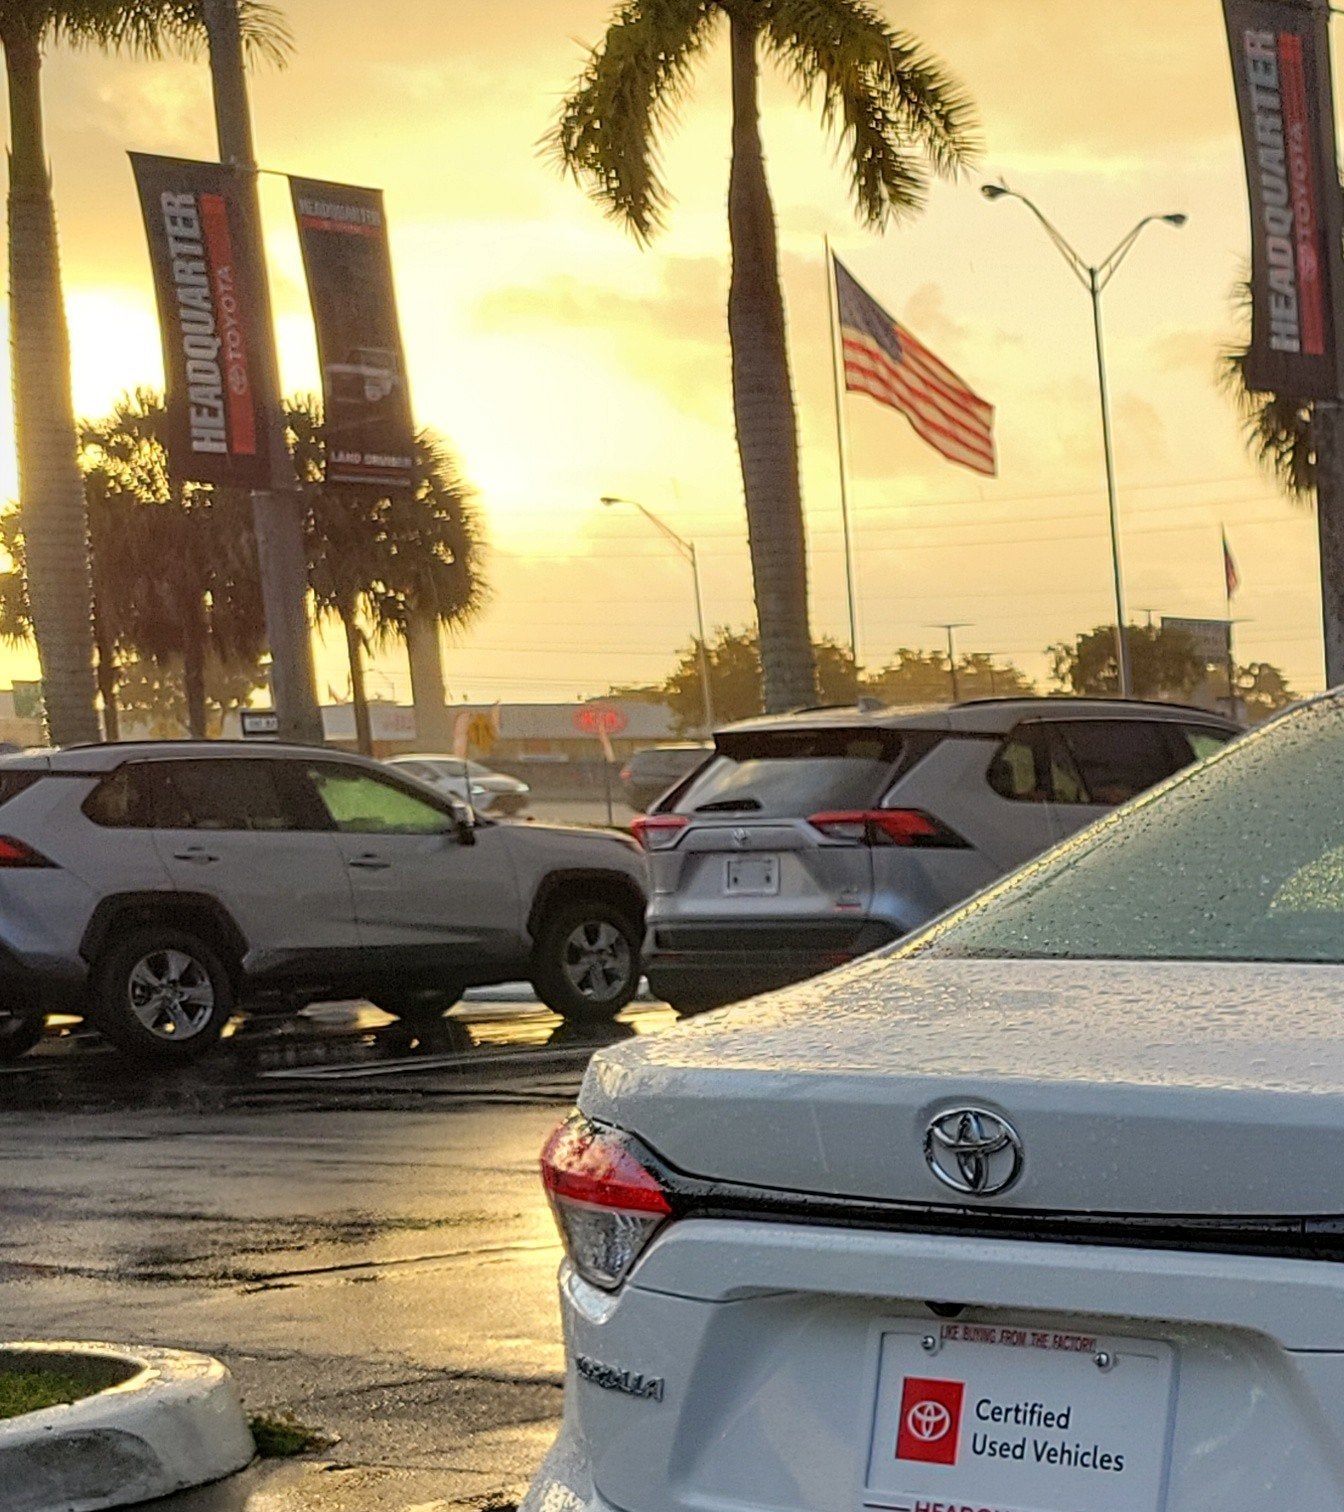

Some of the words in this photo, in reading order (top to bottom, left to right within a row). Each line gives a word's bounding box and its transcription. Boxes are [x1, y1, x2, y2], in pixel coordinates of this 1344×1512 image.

[1245, 30, 1301, 352] HEADQUARTER
[161, 191, 227, 453] HEADQUARTER
[216, 265, 243, 362] TOYOTA
[1000, 1329, 1027, 1346] FROM
[1031, 1332, 1049, 1348] THE
[975, 1399, 1071, 1430] Certified
[971, 1433, 1026, 1460] Used
[1033, 1439, 1125, 1472] Vehicles
